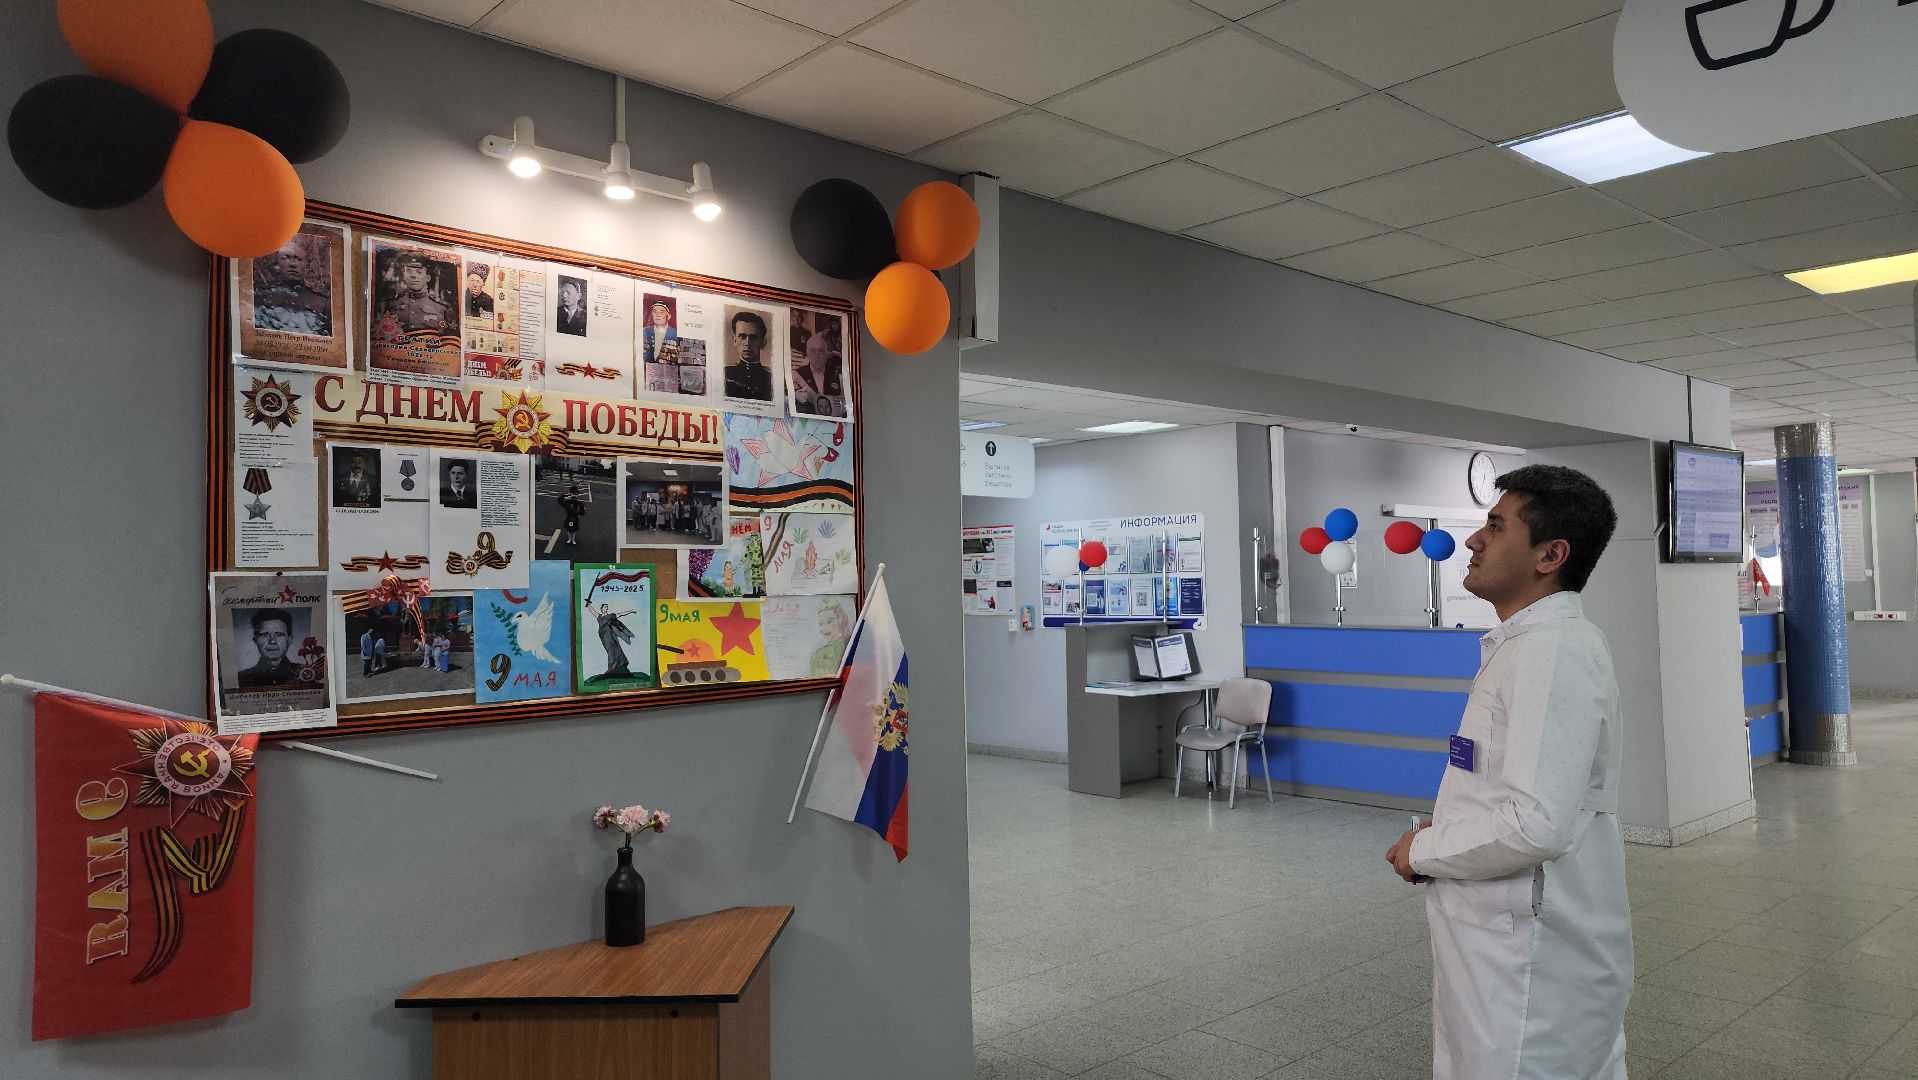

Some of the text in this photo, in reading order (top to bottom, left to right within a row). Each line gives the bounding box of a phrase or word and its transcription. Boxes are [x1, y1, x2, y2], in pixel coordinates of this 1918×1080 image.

[315, 375, 345, 413] С
[356, 379, 484, 425] ДНЕМ
[562, 399, 719, 447] ПОБЕДЫ!
[1120, 514, 1197, 529] ИНФОРМАЦИЯ
[601, 584, 645, 593] 1945-2025
[485, 653, 557, 692] 9 МАЯ
